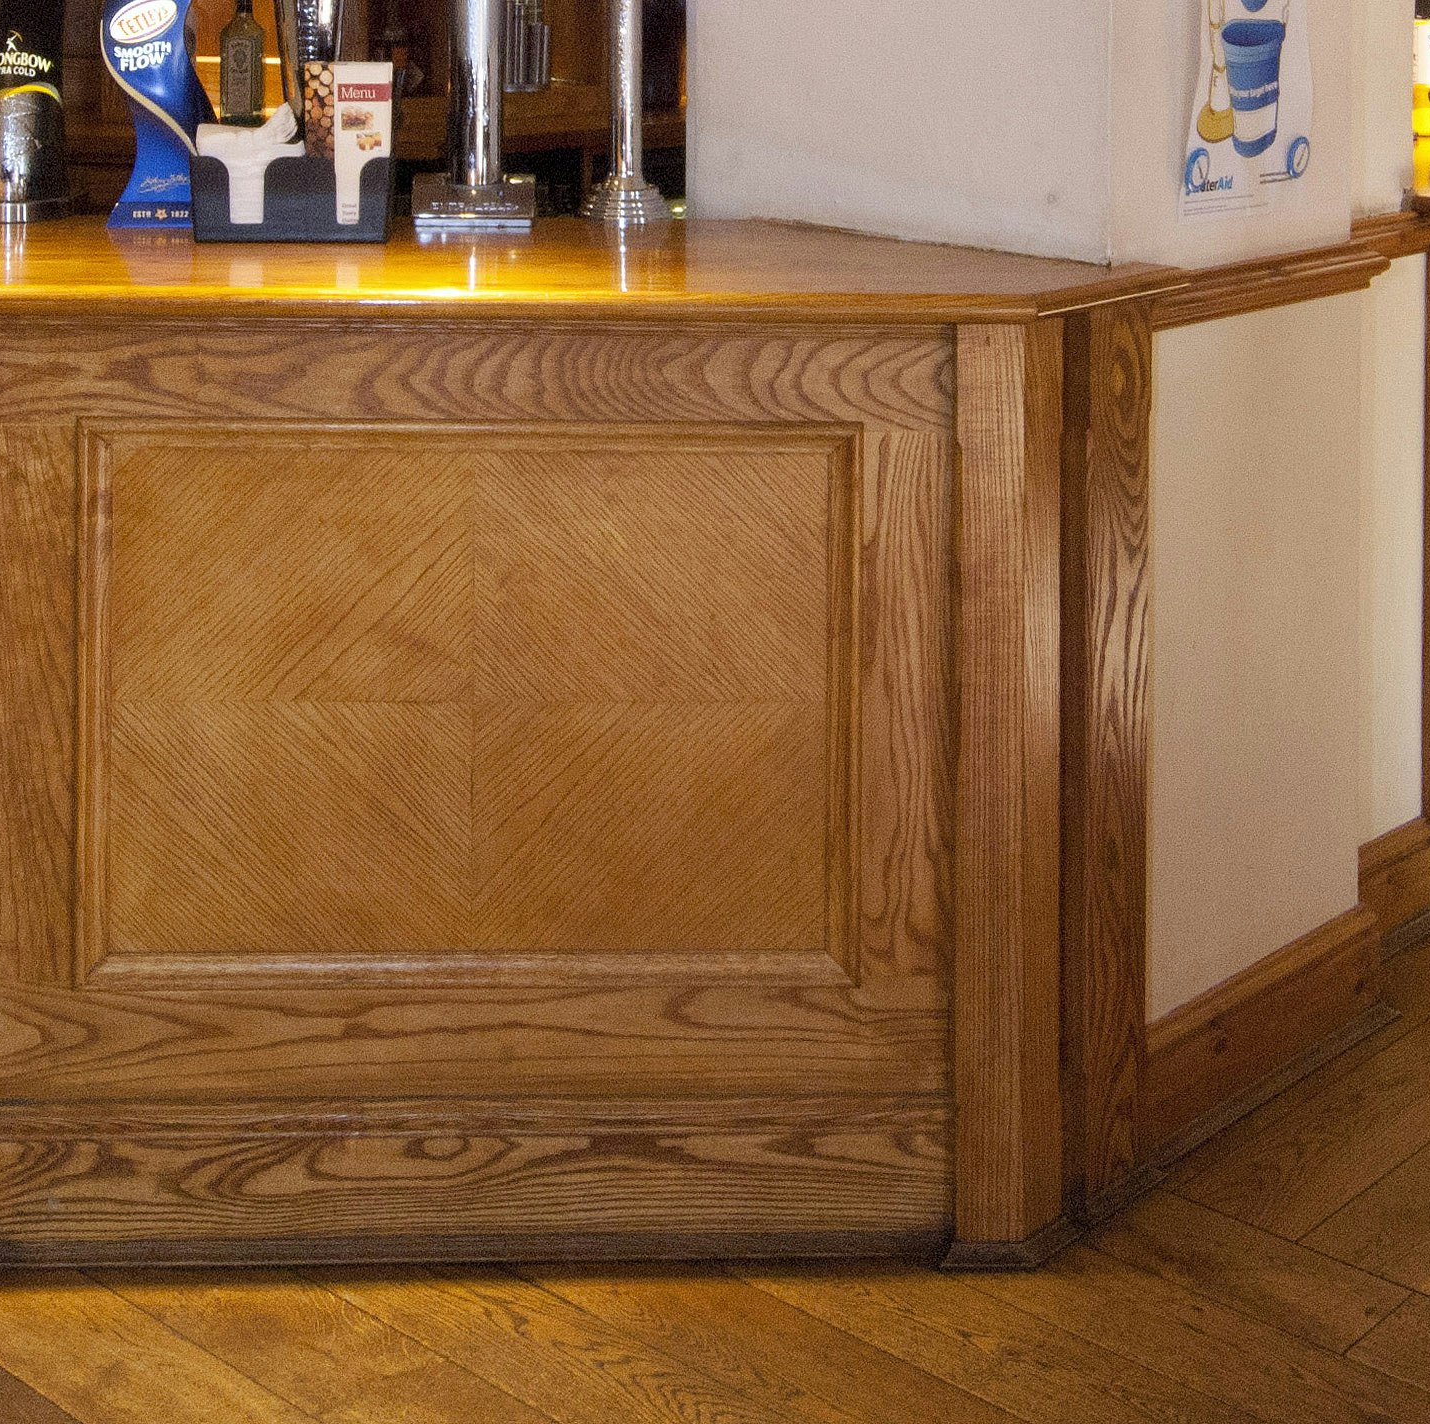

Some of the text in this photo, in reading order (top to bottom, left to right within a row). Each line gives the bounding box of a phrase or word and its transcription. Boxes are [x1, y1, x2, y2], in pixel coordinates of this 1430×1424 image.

[114, 41, 171, 59] SMOOTH
[120, 52, 166, 73] FLOW
[13, 65, 37, 77] COLD
[341, 87, 376, 99] Menu
[1200, 176, 1233, 192] aterAid
